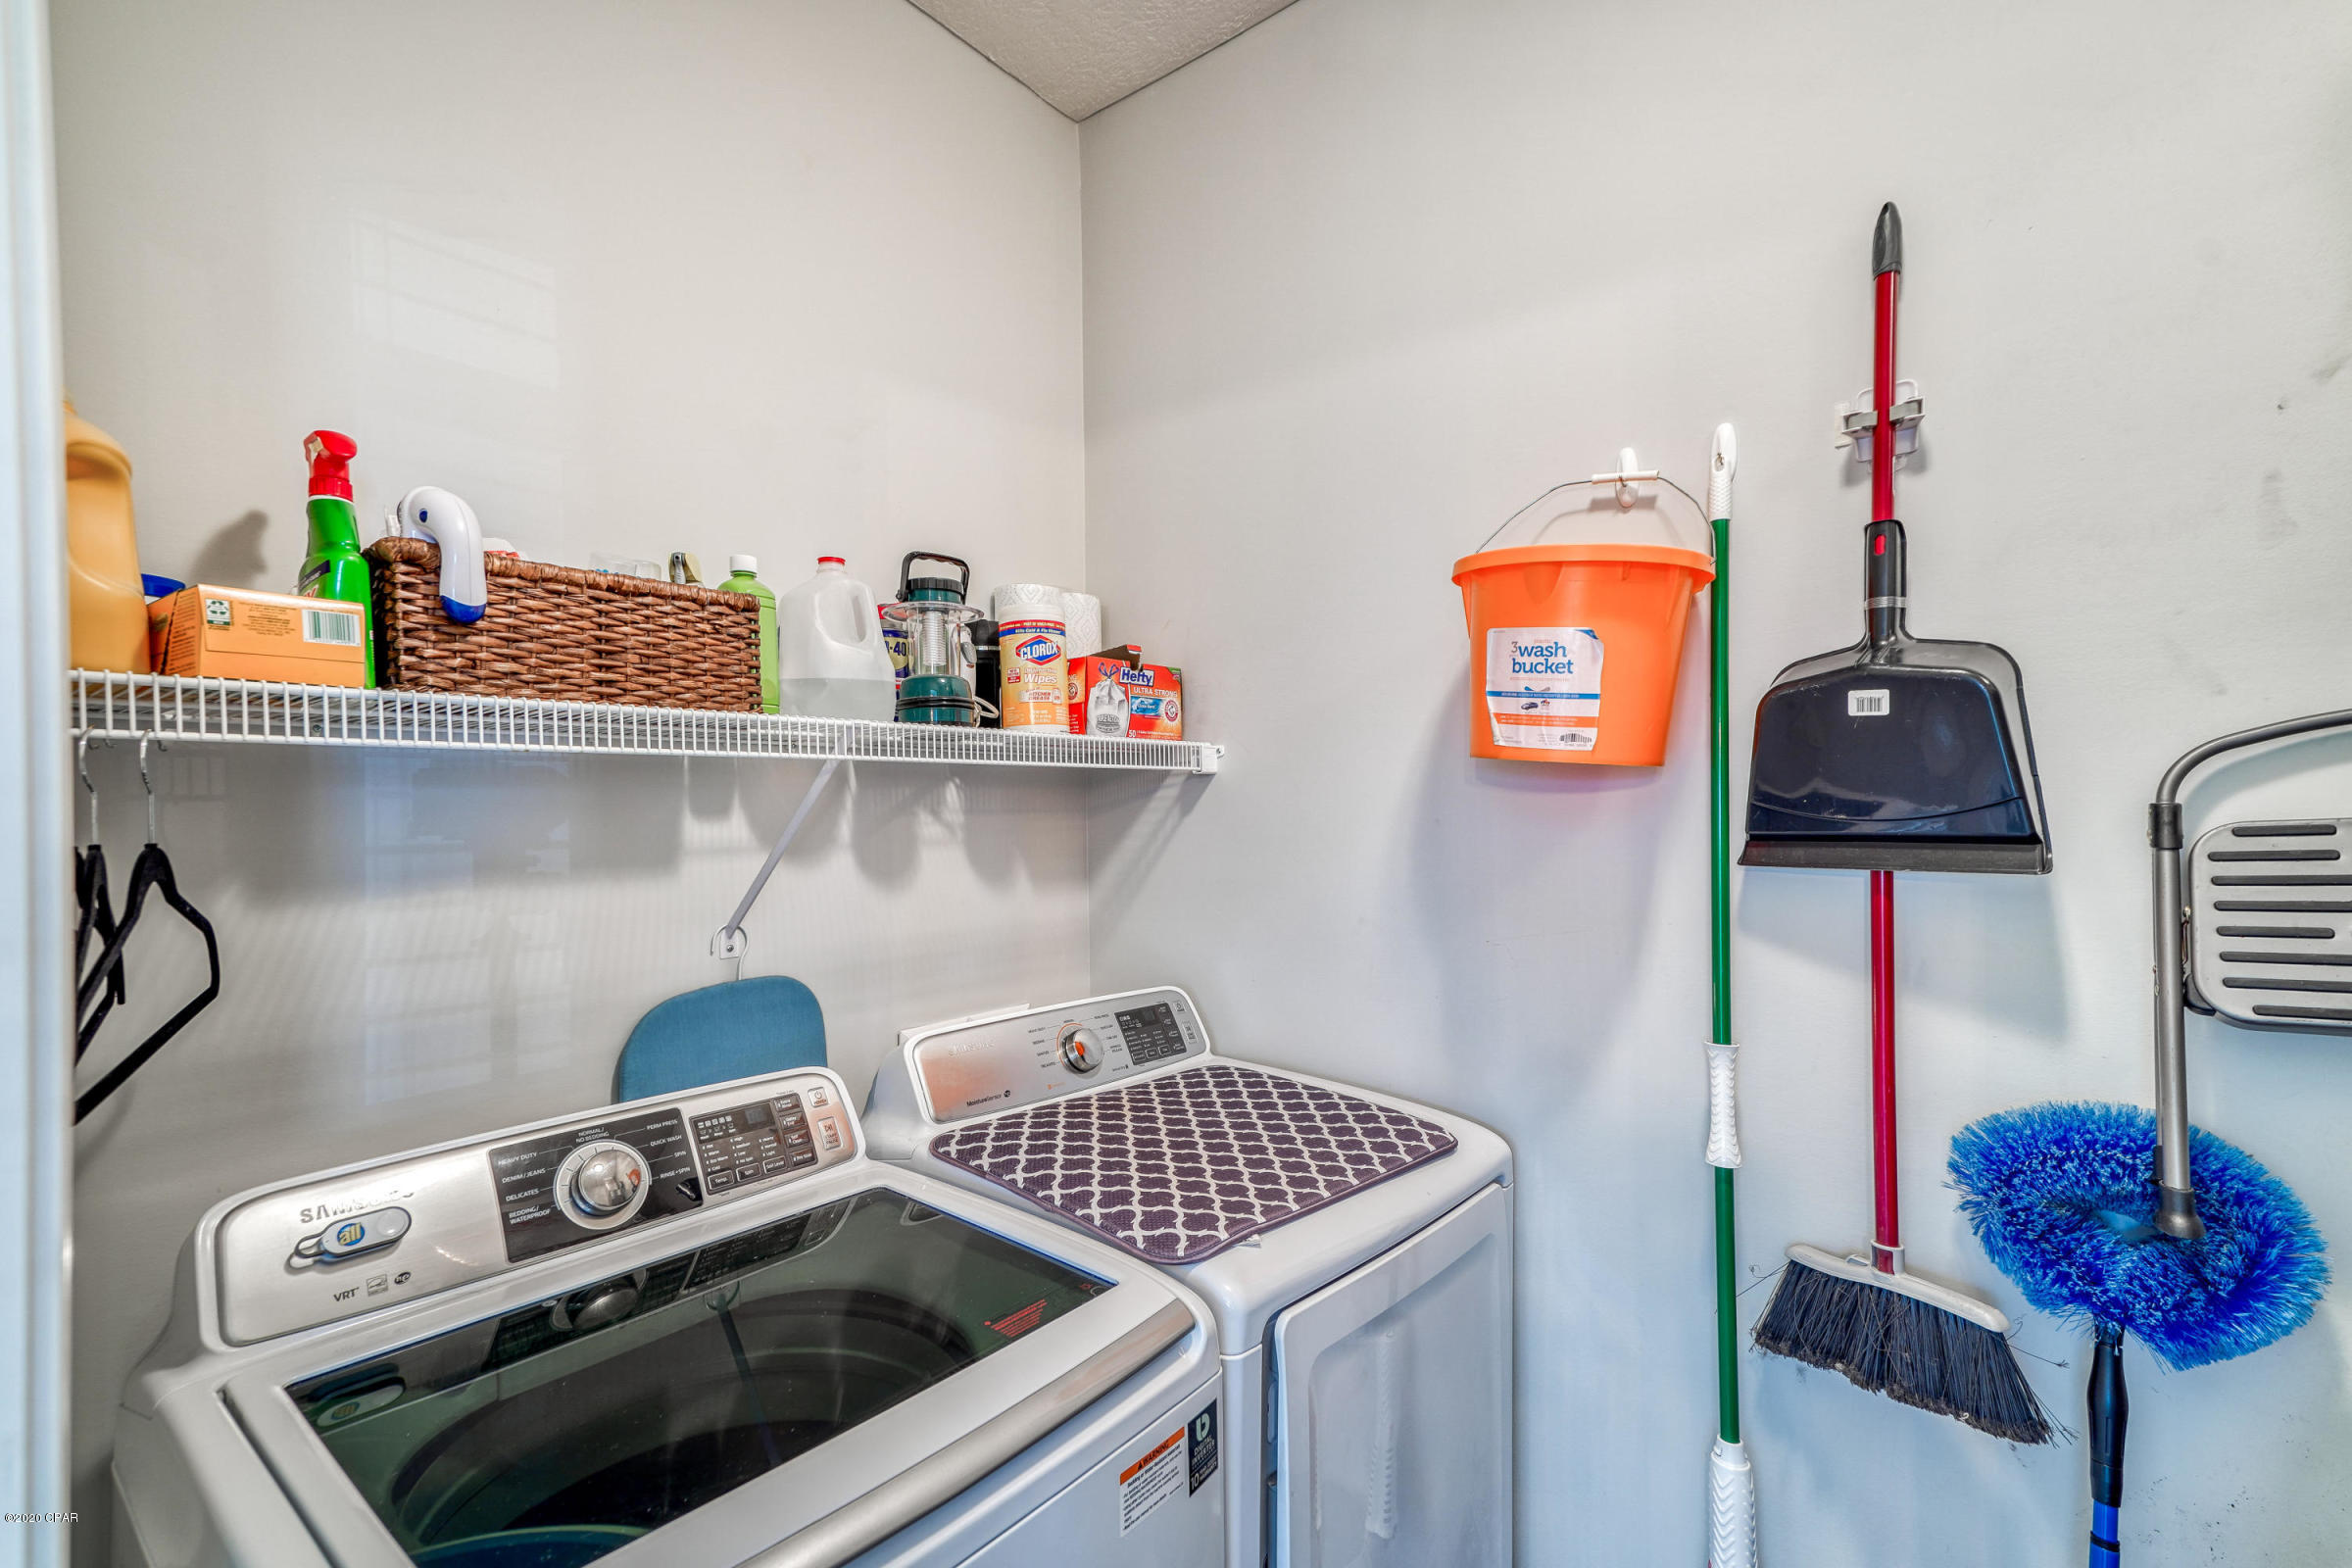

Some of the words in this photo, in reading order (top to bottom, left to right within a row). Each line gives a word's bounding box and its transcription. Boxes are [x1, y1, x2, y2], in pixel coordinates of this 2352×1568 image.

[885, 641, 907, 657] -40
[1020, 642, 1058, 661] CLOROX
[1511, 641, 1518, 654] 3
[1518, 641, 1567, 658] wash
[1512, 658, 1574, 674] bucket
[1024, 673, 1057, 685] Wipes
[1121, 668, 1152, 687] Hefty
[650, 1138, 666, 1147] QUICK
[520, 1152, 537, 1160] DUTY
[506, 1188, 540, 1201] DELICATES
[510, 1208, 551, 1225] WATERPROOF
[339, 1222, 363, 1247] all
[1191, 1472, 1200, 1491] 10
